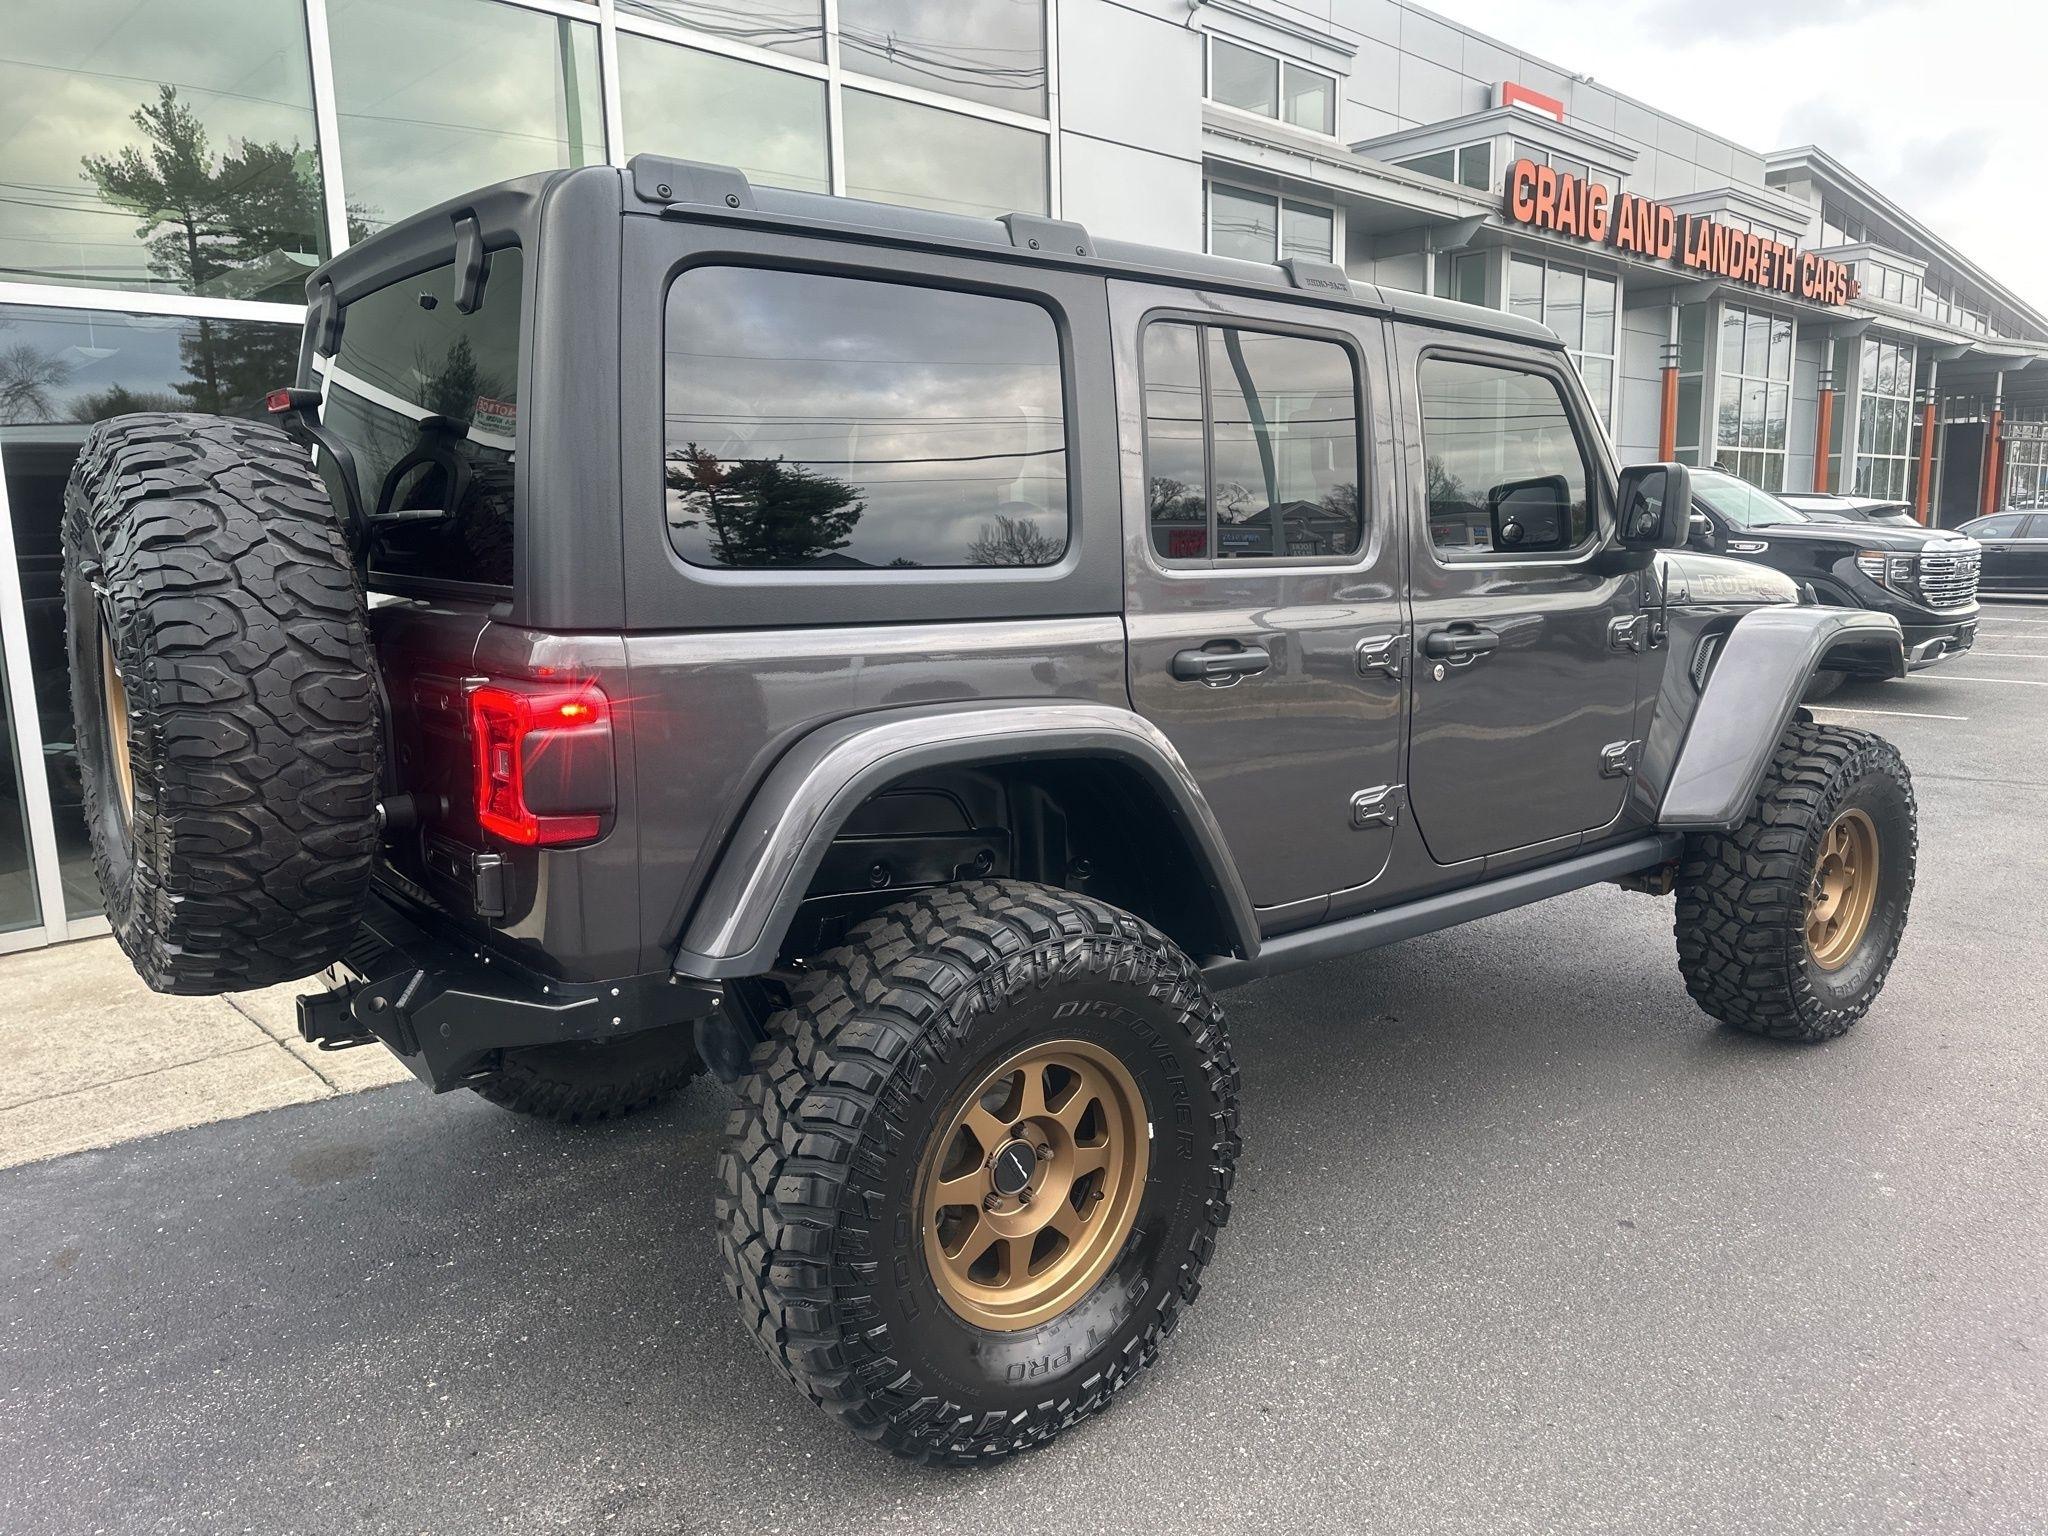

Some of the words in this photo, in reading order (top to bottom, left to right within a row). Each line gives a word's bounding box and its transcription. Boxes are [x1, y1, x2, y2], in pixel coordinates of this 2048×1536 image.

[1505, 158, 1608, 242] CRAIG
[1612, 193, 1674, 260] AND
[1679, 213, 1797, 293] LANDRETH
[1802, 251, 1848, 306] CARS
[1052, 999, 1194, 1160] DISCOVERER
[1005, 1346, 1071, 1384] PRO
[1084, 1273, 1149, 1359] STT
